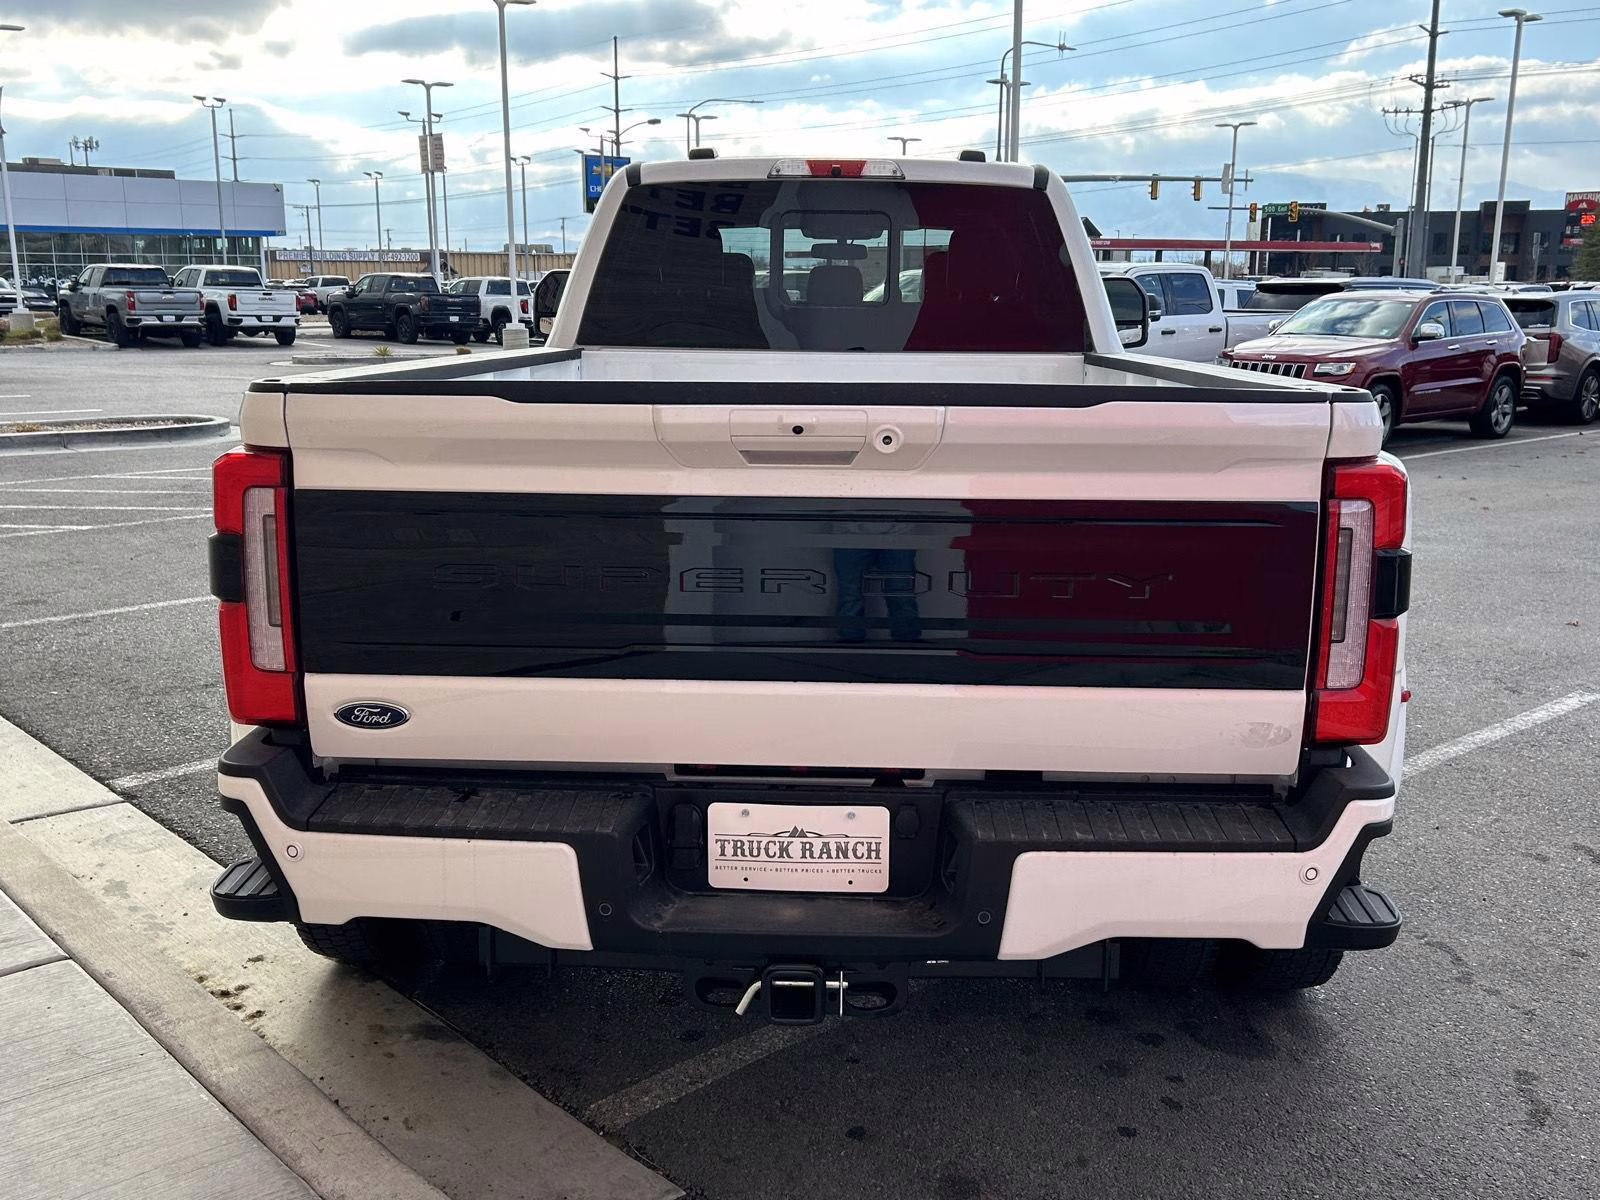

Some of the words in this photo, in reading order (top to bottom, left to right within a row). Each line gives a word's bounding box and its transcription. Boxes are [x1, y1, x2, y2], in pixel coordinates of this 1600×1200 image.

[278, 252, 312, 260] PREMIER
[313, 252, 346, 261] BUILDING
[349, 252, 375, 261] SUPPLY
[434, 563, 827, 594] SUPER
[862, 569, 1174, 599] DUTY
[351, 707, 392, 724] Ford
[714, 838, 794, 860] TRUCK
[799, 840, 882, 861] RANCH
